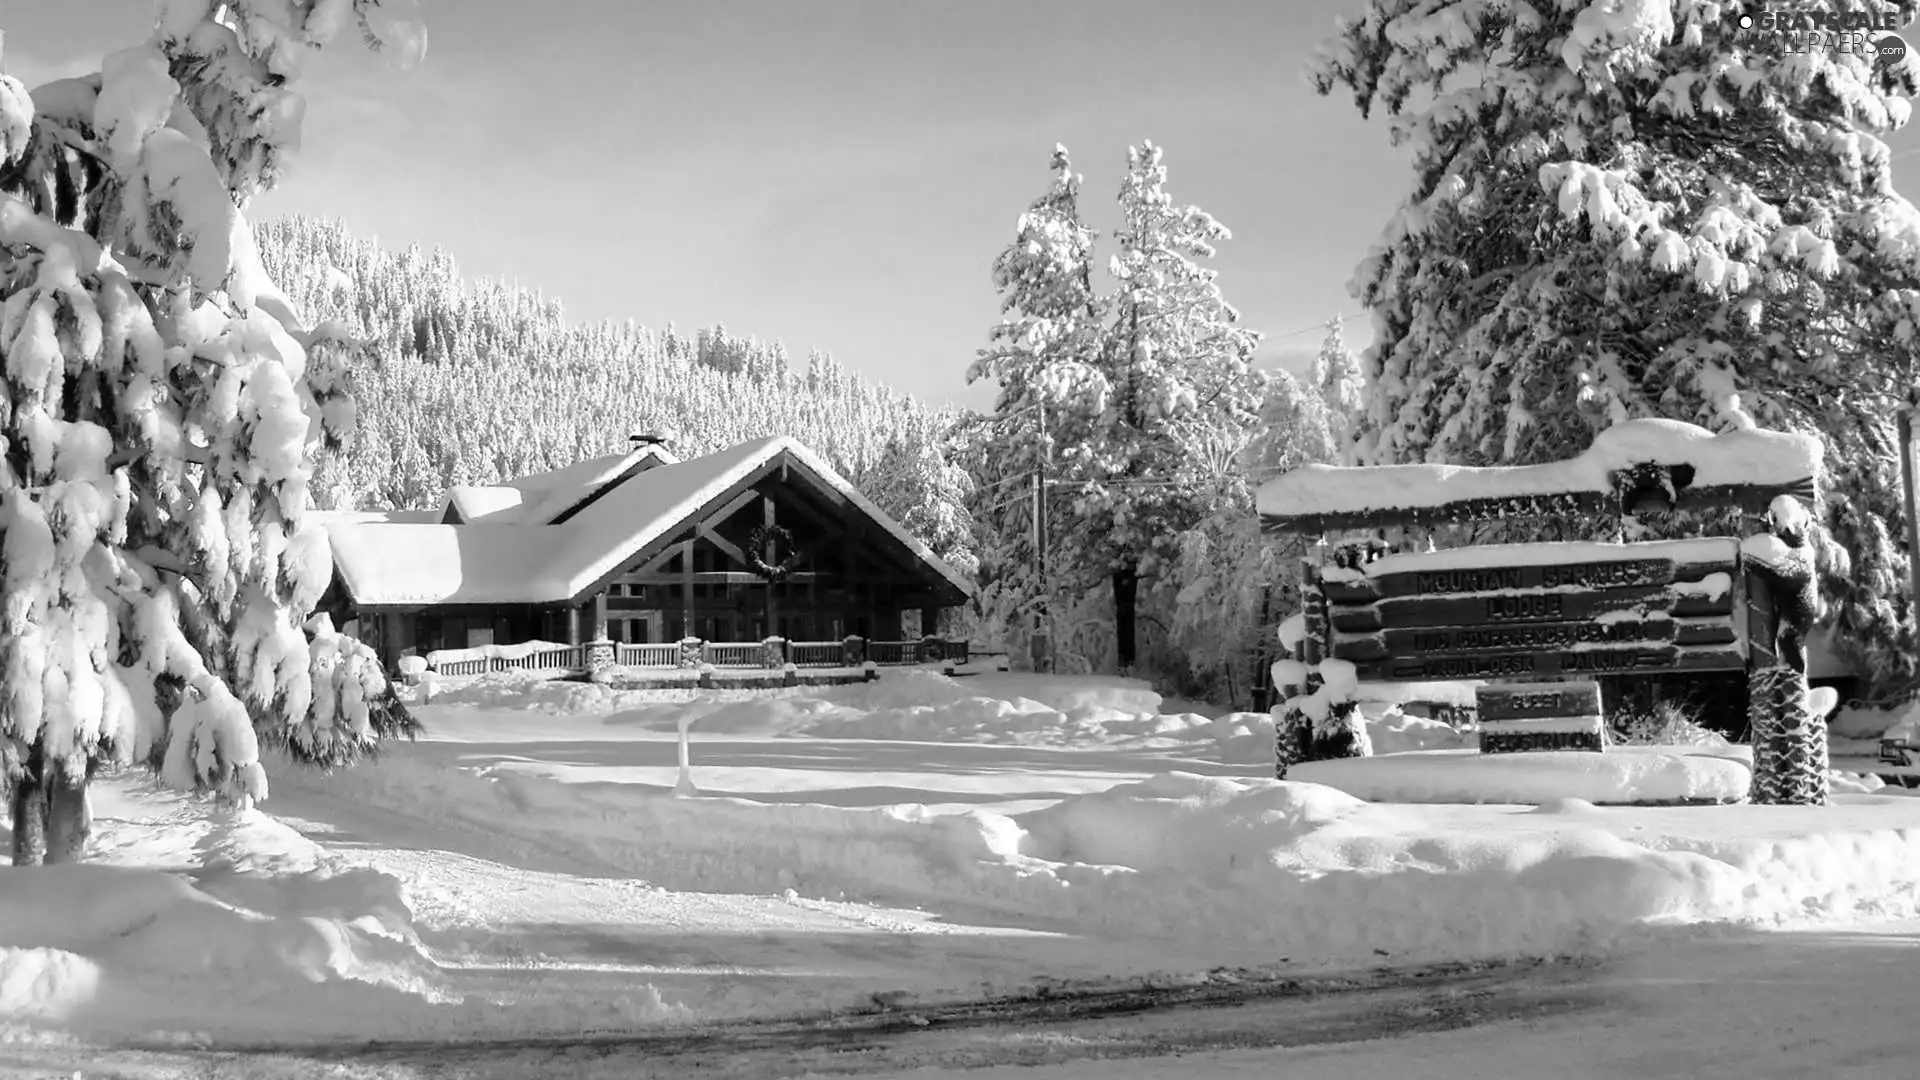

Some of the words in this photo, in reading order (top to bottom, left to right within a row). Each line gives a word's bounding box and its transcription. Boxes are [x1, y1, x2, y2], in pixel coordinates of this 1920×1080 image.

[1417, 568, 1522, 593] MOUNTAIN
[1542, 560, 1640, 589] SPRINGS
[1487, 596, 1562, 618] LODGE
[1489, 655, 1534, 673] DESK
[1561, 651, 1636, 670] PARKING
[1511, 694, 1561, 709] GUEST
